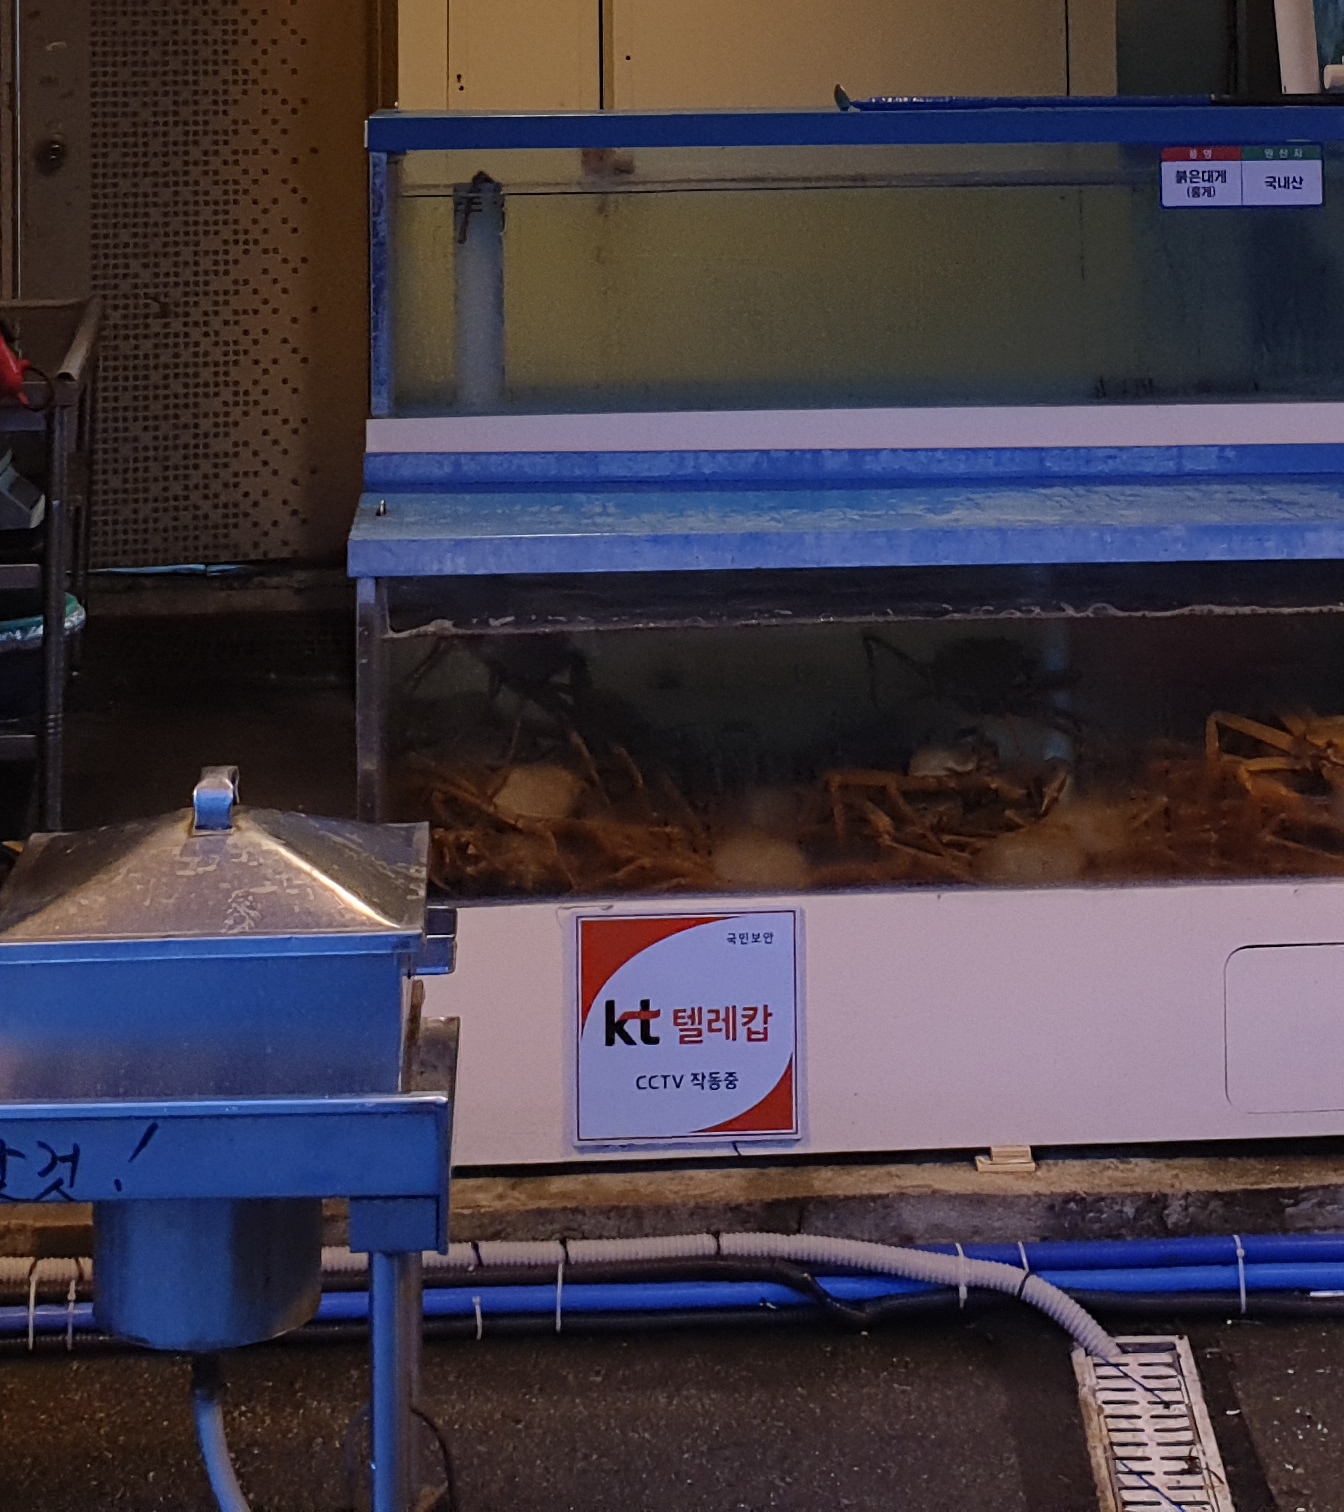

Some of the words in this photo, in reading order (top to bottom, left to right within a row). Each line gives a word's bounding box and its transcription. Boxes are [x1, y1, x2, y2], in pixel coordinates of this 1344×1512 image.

[1176, 170, 1227, 185] 붉은대게
[1265, 176, 1304, 190] 국내산
[726, 932, 774, 945] 국민보안
[605, 999, 661, 1046] kt
[673, 1004, 773, 1045] 텔레캅
[636, 1074, 684, 1090] CCTV
[690, 1071, 739, 1091] 작동중
